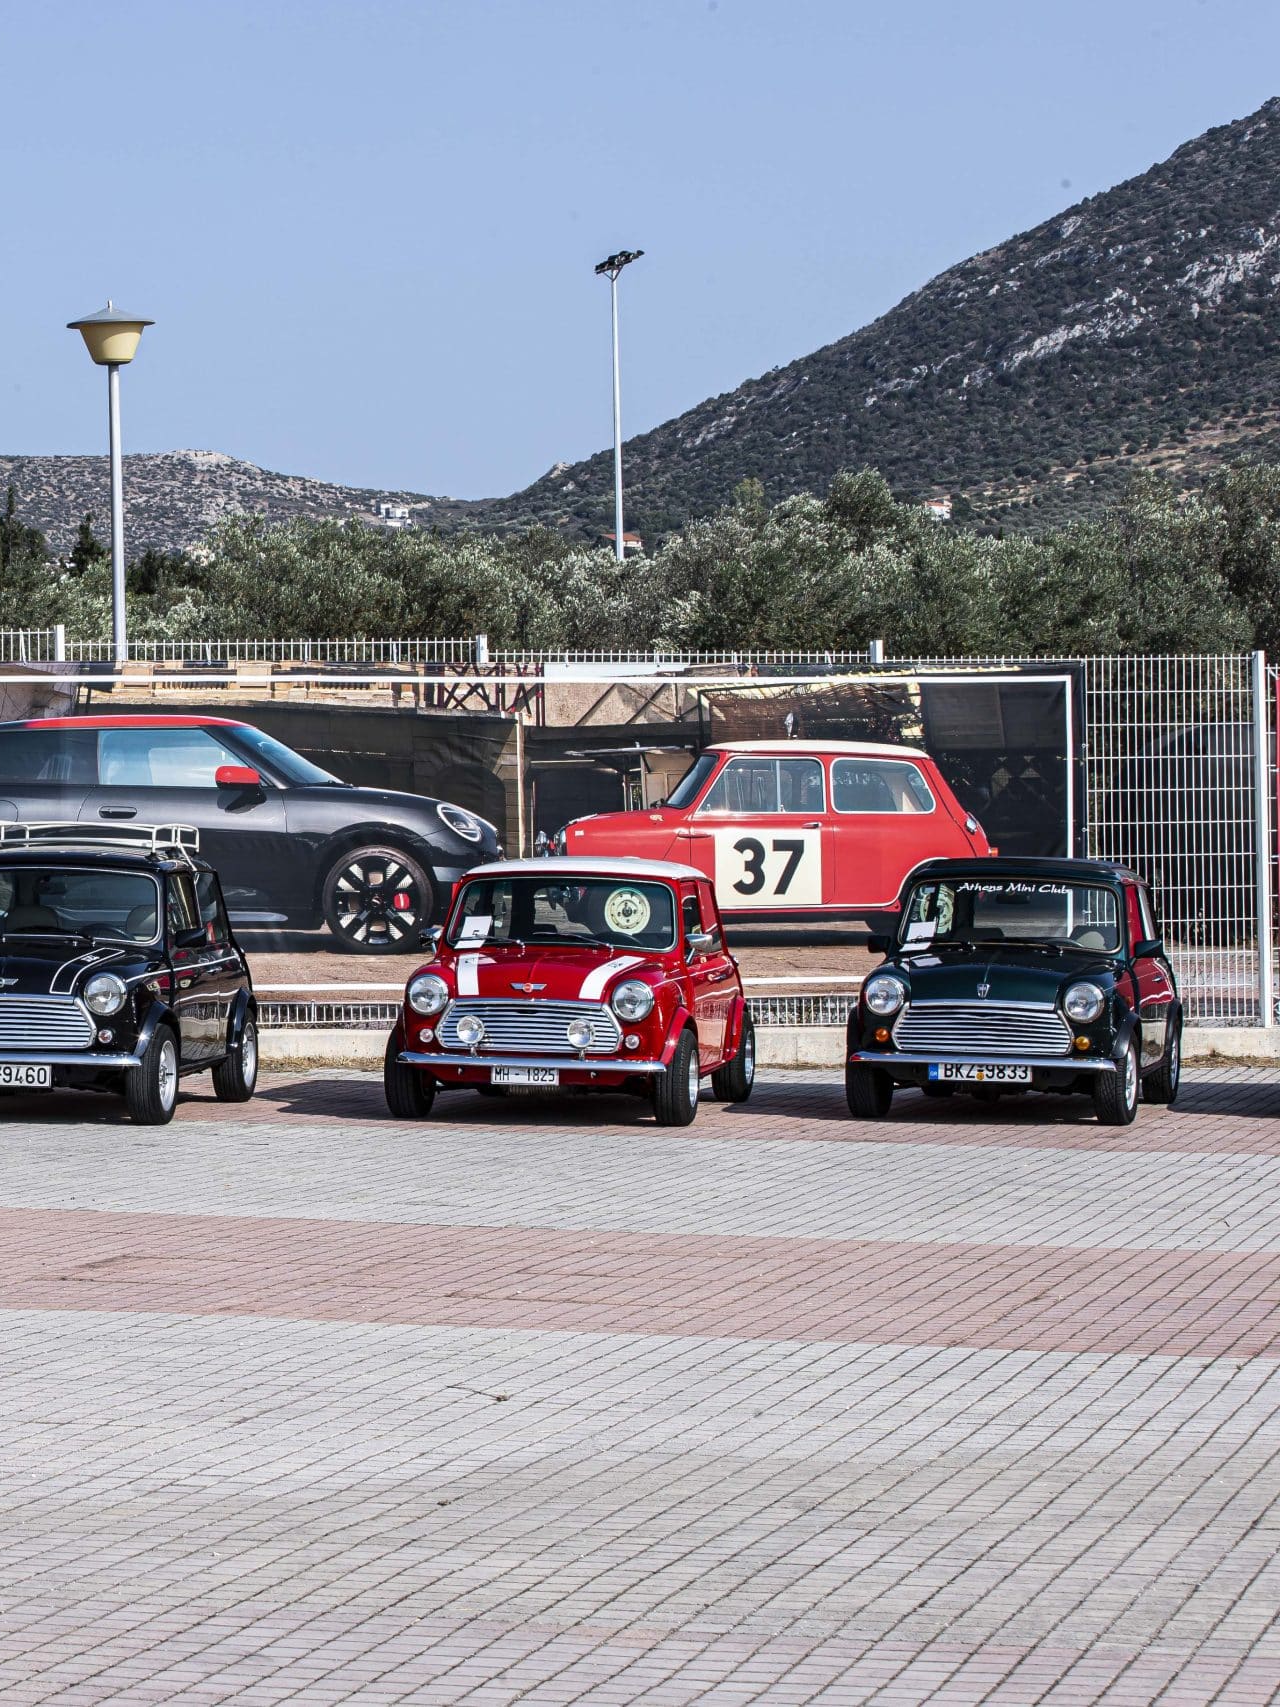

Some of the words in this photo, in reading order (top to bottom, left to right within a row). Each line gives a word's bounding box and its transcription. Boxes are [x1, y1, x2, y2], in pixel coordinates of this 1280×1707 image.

[732, 837, 805, 895] 37
[956, 882, 1003, 893] Athens
[1005, 882, 1035, 893] Mini
[1039, 884, 1070, 894] Club
[495, 1066, 510, 1081] MH
[527, 1067, 555, 1082] 1825
